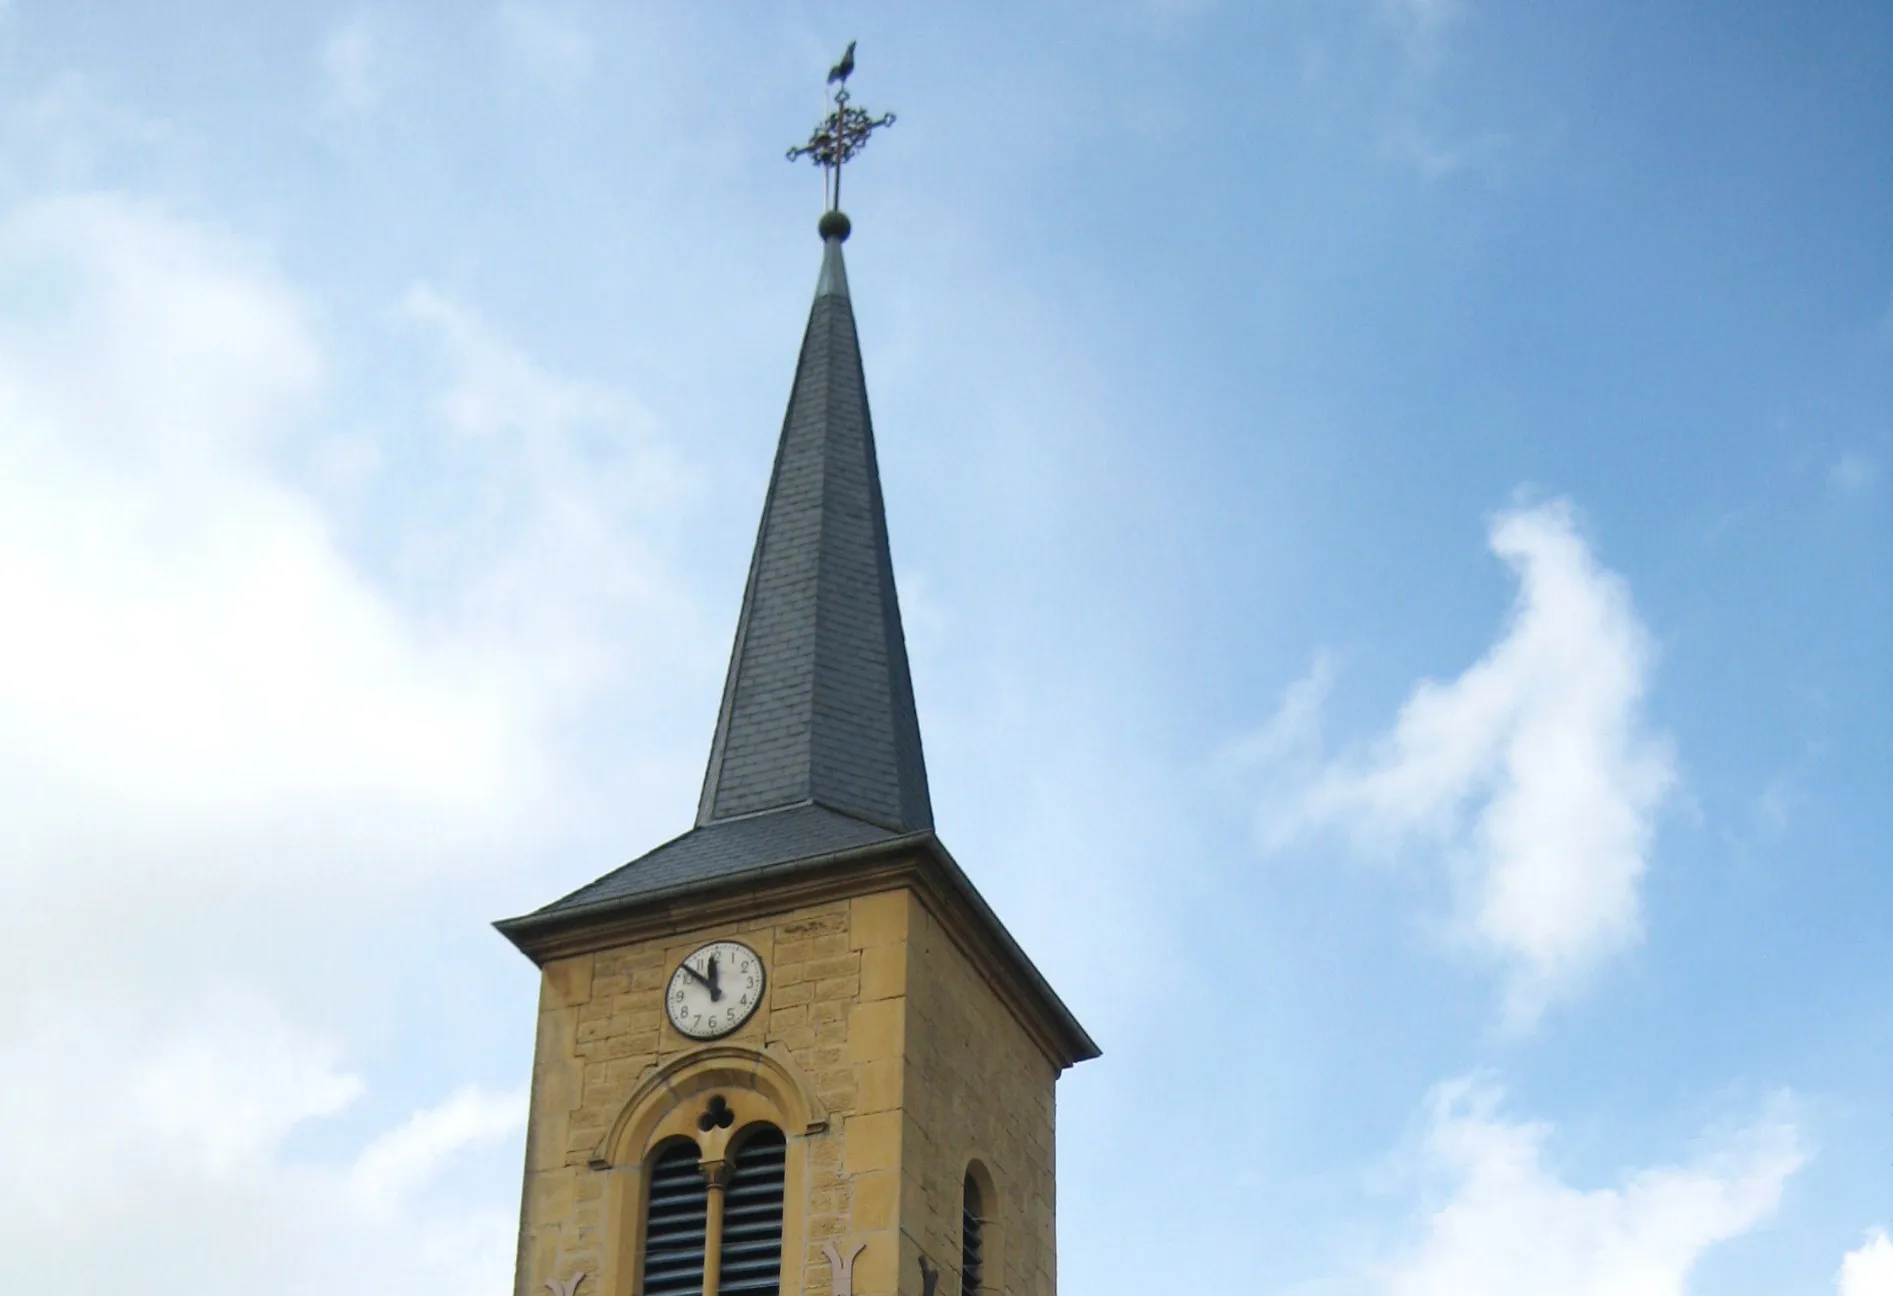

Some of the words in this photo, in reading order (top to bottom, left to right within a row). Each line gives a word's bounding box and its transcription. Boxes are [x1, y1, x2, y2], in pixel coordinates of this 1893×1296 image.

[697, 959, 704, 970] 11
[740, 961, 749, 973] 2
[746, 976, 754, 989] 3
[676, 991, 684, 1003] 9
[740, 994, 747, 1005] 4
[680, 1006, 688, 1018] 8
[727, 1008, 734, 1020] 5
[693, 1015, 702, 1028] 7
[708, 1016, 717, 1028] 6
